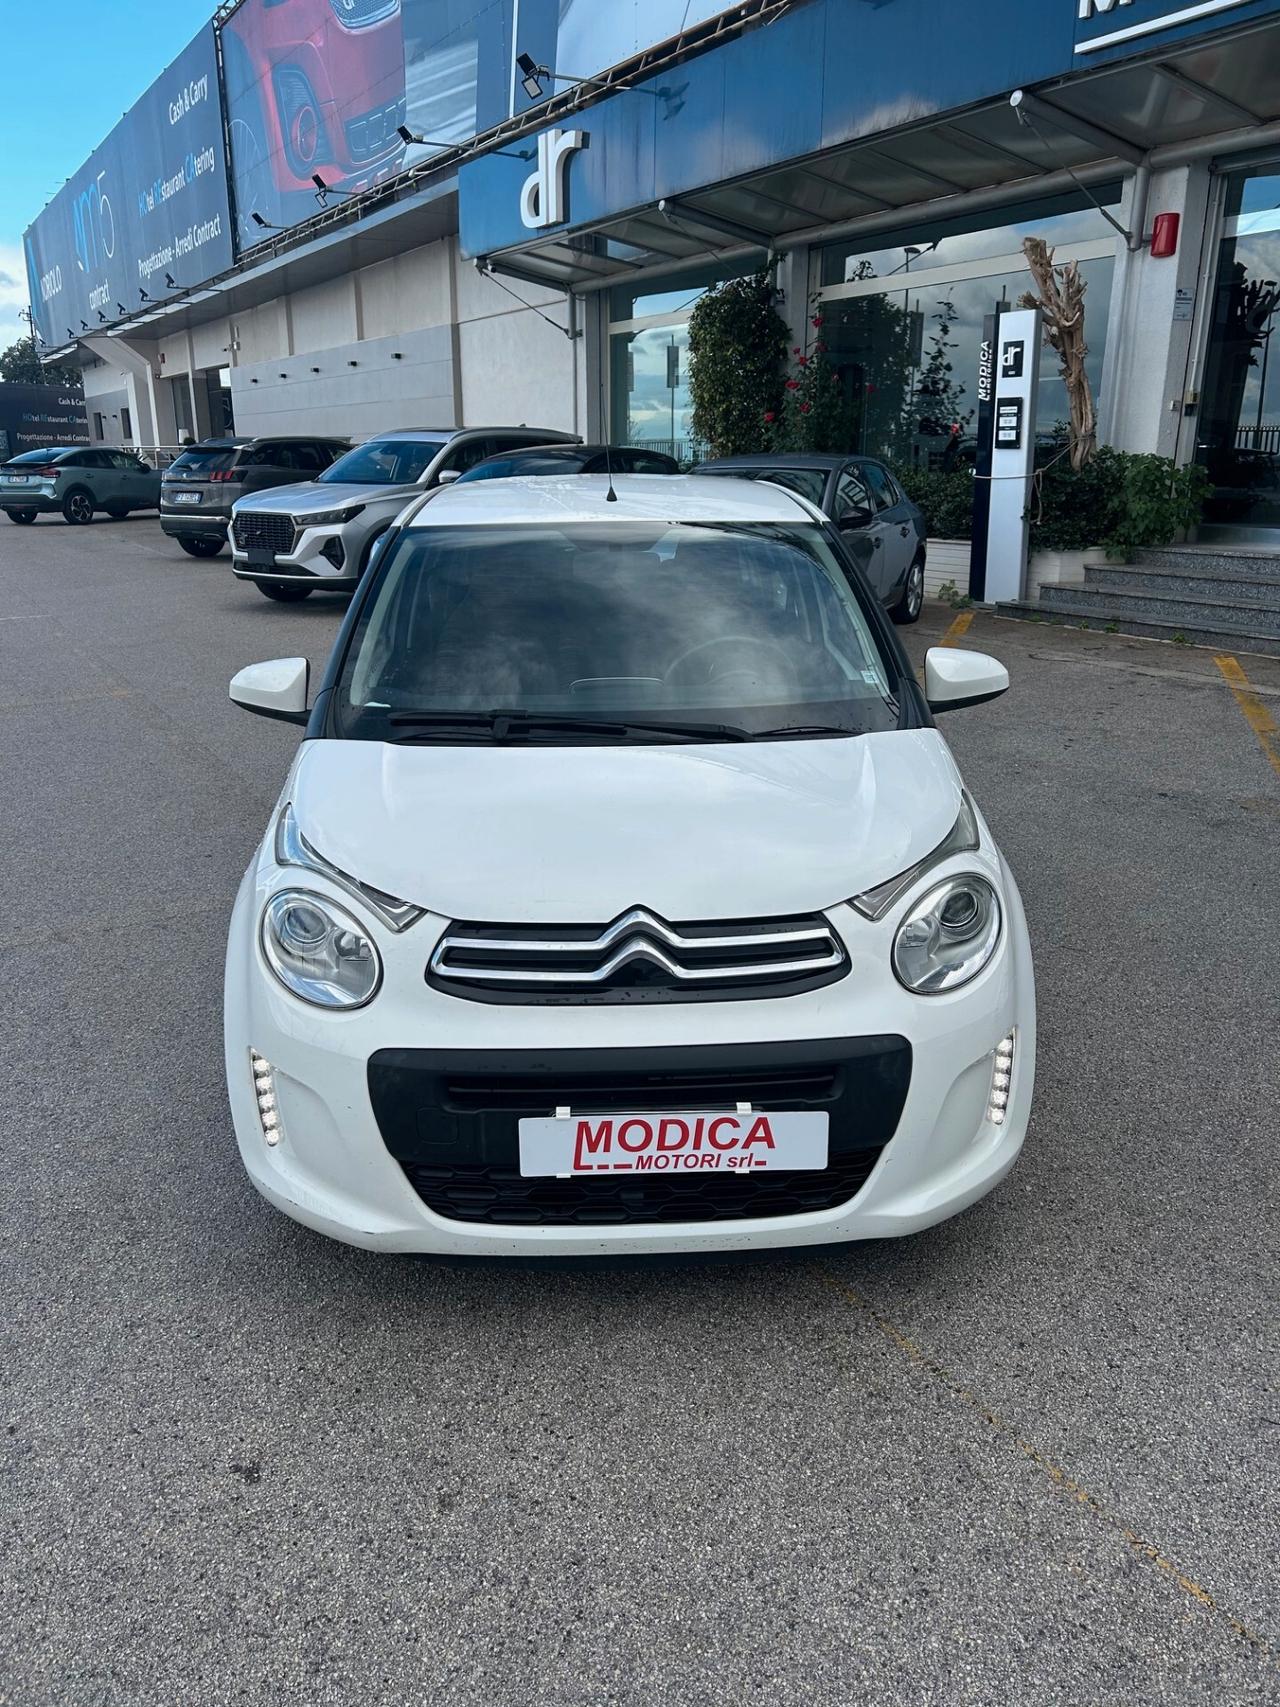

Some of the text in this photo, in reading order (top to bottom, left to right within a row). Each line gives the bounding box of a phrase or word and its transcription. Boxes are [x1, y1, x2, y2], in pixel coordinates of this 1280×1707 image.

[169, 73, 208, 125] Cash & Carry
[153, 169, 185, 210] REstaurant
[184, 145, 215, 186] CAtering
[520, 128, 583, 228] dr
[138, 244, 173, 279] Progettazione
[175, 229, 193, 259] Arredi
[193, 213, 222, 248] Contract
[89, 278, 110, 310] contract
[978, 341, 990, 400] MODICA
[1002, 346, 1021, 366] dr
[40, 413, 68, 423] REstaurant
[68, 415, 88, 424] CAterin
[58, 397, 71, 406] Cash
[16, 432, 53, 442] Progettazione
[57, 433, 72, 441] Arredi
[72, 434, 91, 442] Contrac
[573, 1116, 776, 1153] MODICA
[635, 1152, 753, 1170] MOTORI srl
